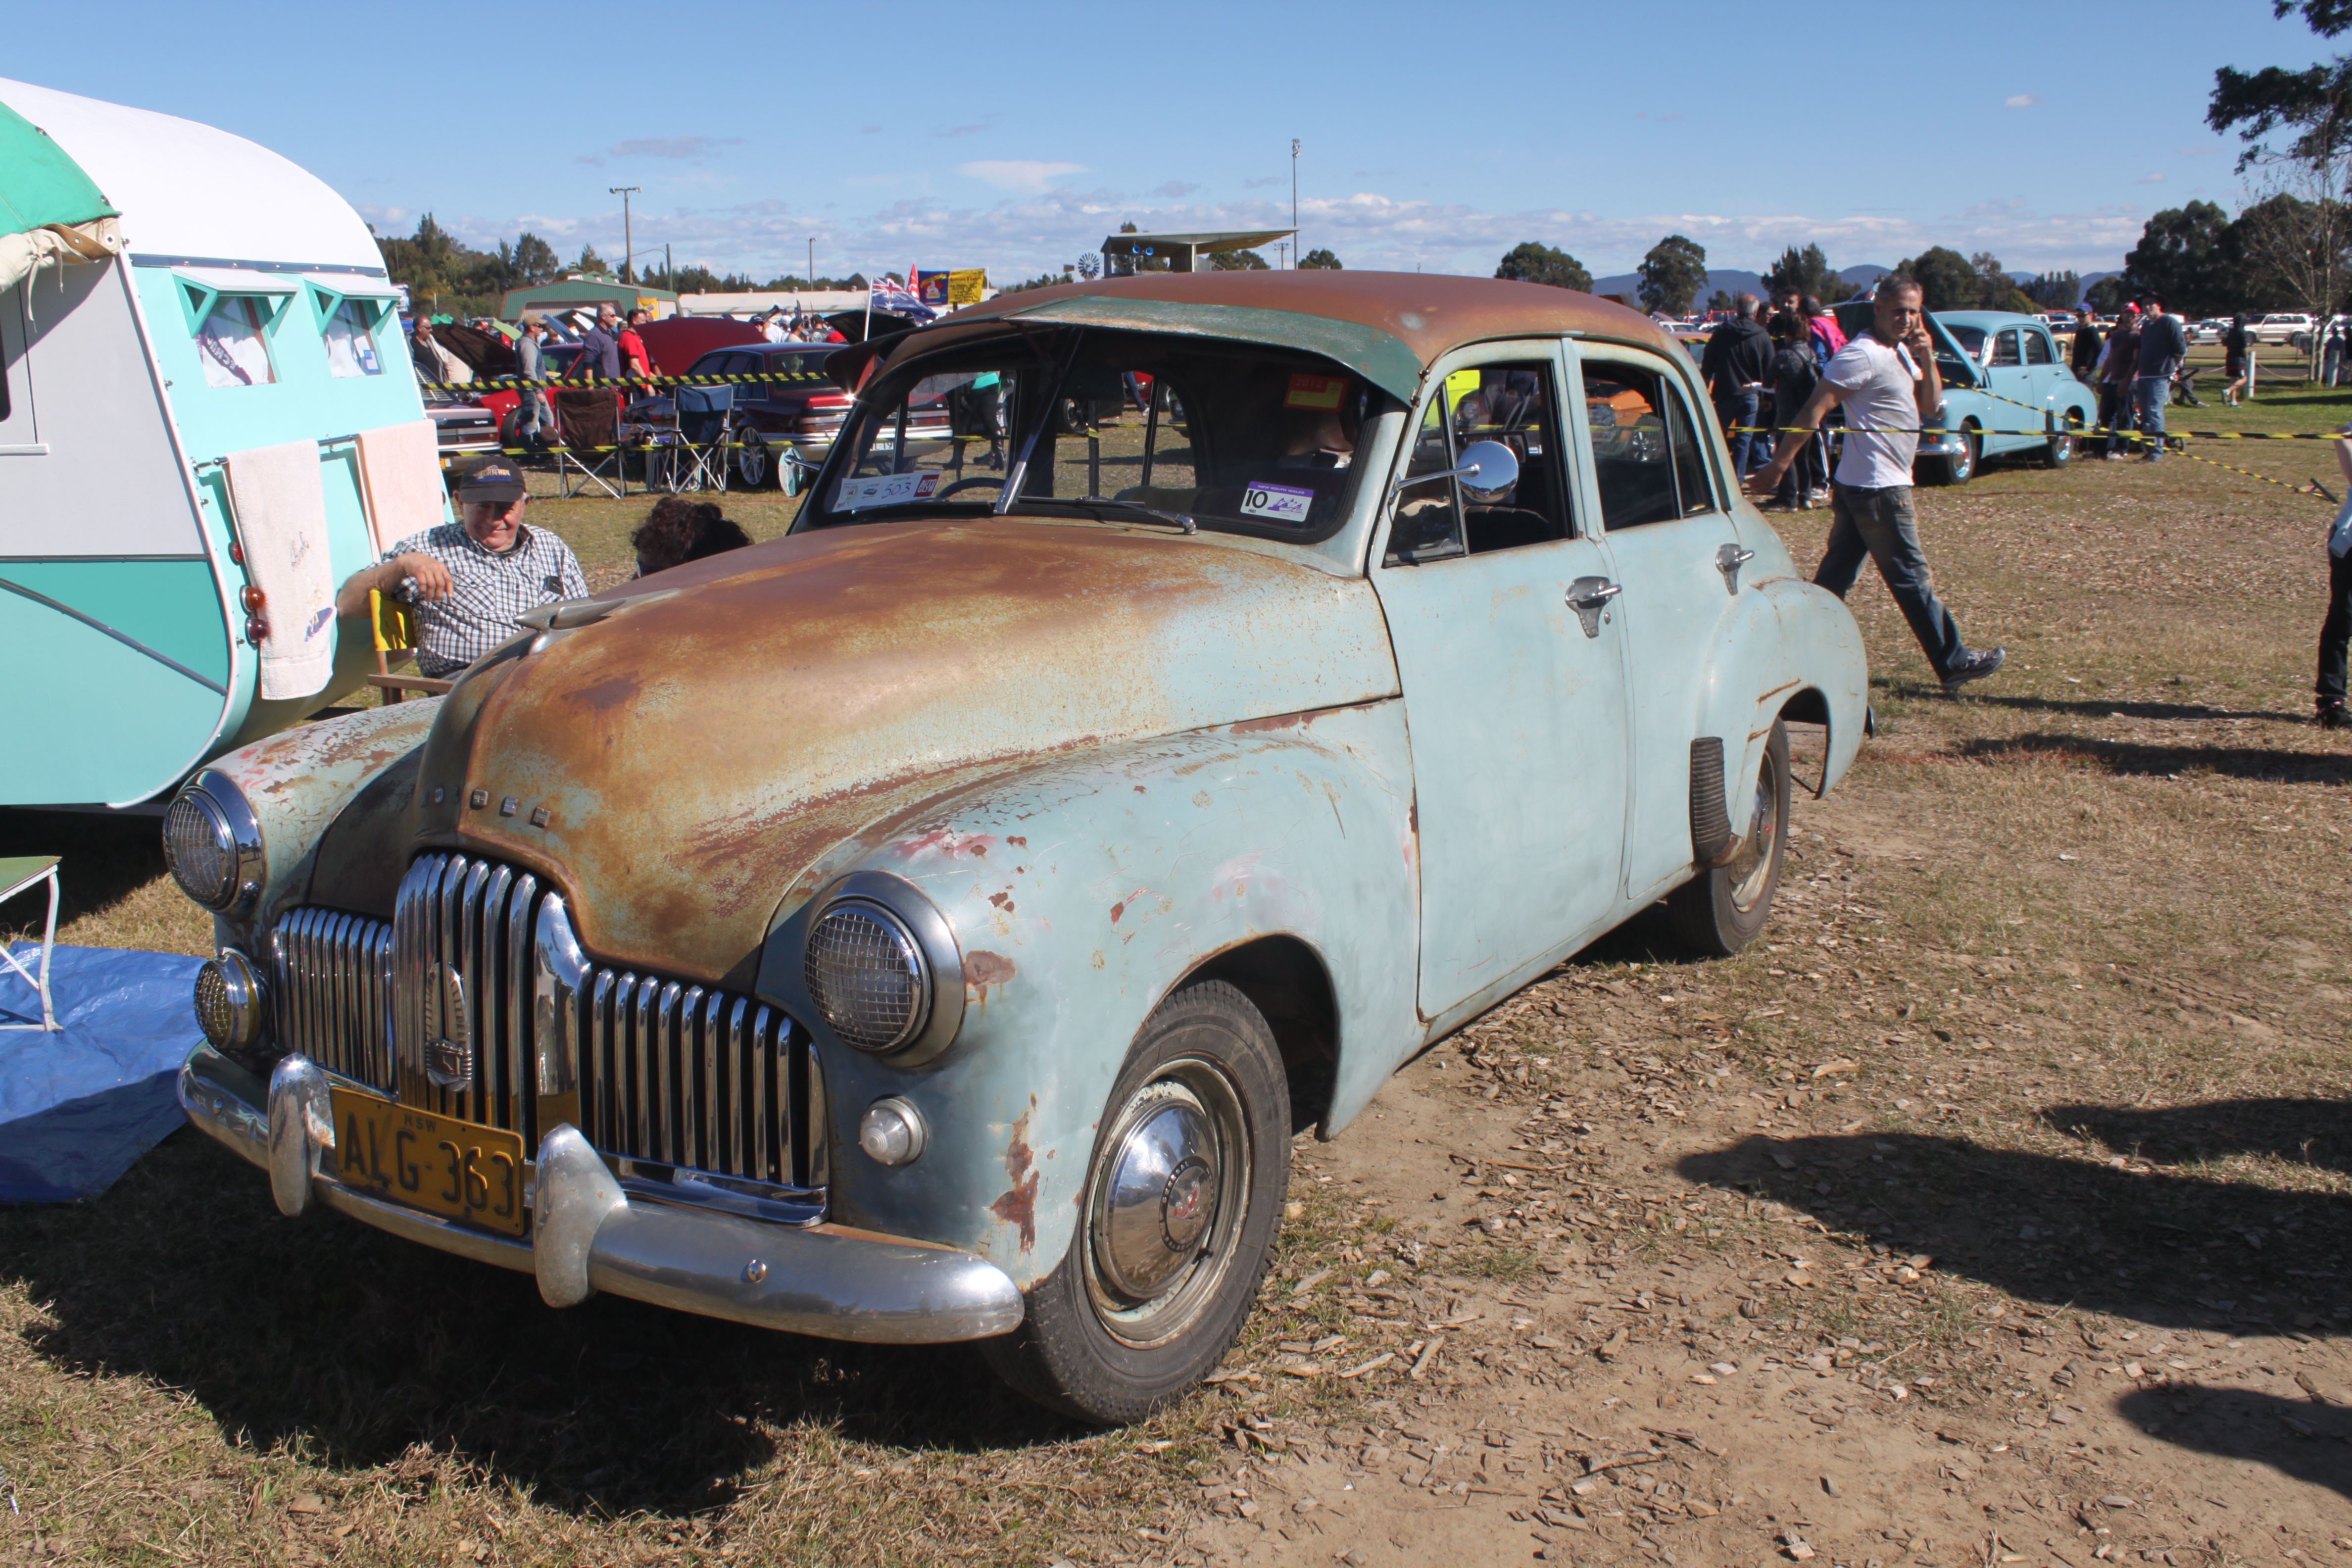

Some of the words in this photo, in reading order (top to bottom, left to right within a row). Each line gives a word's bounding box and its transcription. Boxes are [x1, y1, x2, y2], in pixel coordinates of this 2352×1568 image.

[1295, 378, 1323, 388] 2012
[881, 482, 911, 499] 503
[921, 479, 936, 487] AUTO
[1245, 490, 1268, 508] 10
[404, 1116, 437, 1133] NSW
